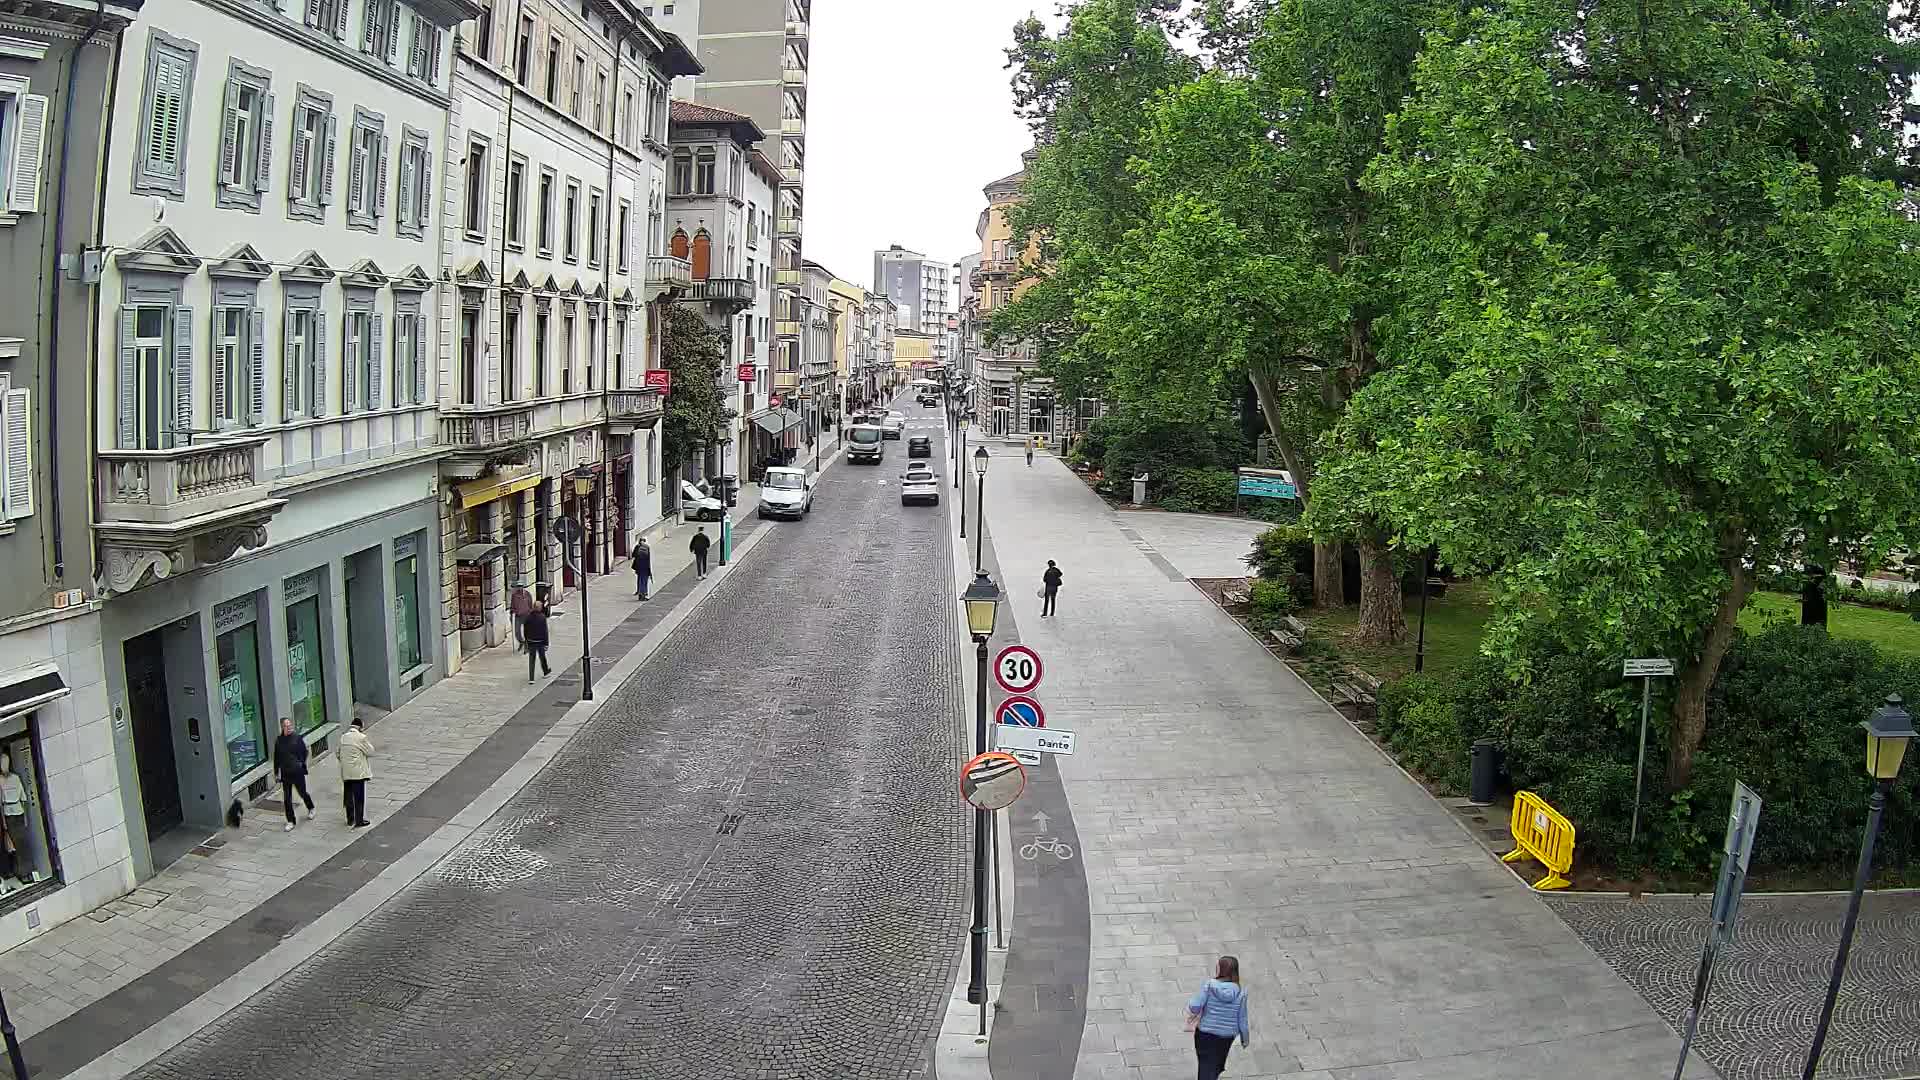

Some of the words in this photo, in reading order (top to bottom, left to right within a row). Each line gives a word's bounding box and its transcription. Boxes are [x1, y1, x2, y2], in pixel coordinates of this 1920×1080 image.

[1005, 658, 1033, 681] 30
[222, 678, 240, 701] 130
[1038, 738, 1070, 750] Dante
